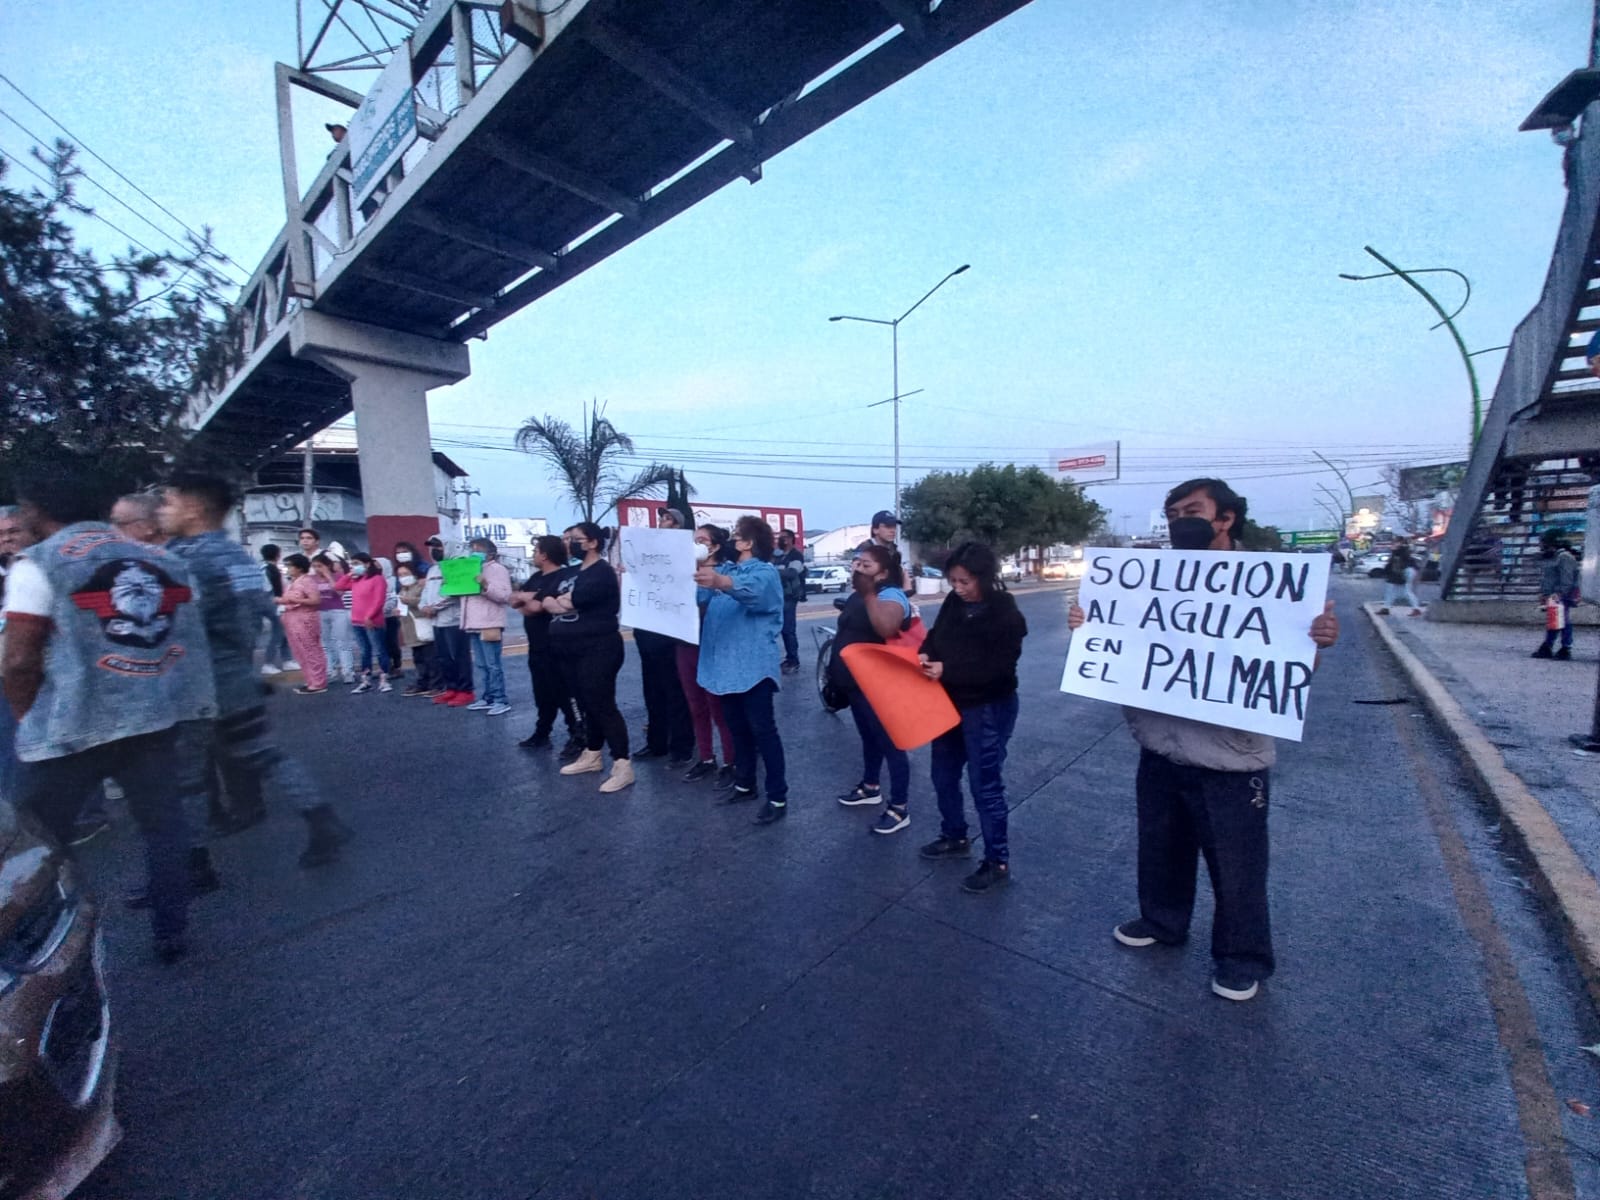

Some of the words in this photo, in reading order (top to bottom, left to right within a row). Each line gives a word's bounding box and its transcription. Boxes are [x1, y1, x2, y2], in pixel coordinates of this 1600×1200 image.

[463, 524, 507, 541] DAVID
[1090, 556, 1310, 602] SOLUCION
[1087, 599, 1125, 626] AL
[1139, 597, 1271, 645] AGUA
[1085, 637, 1123, 655] EN
[1078, 661, 1119, 684] EL
[1142, 643, 1312, 721] PALMAR
